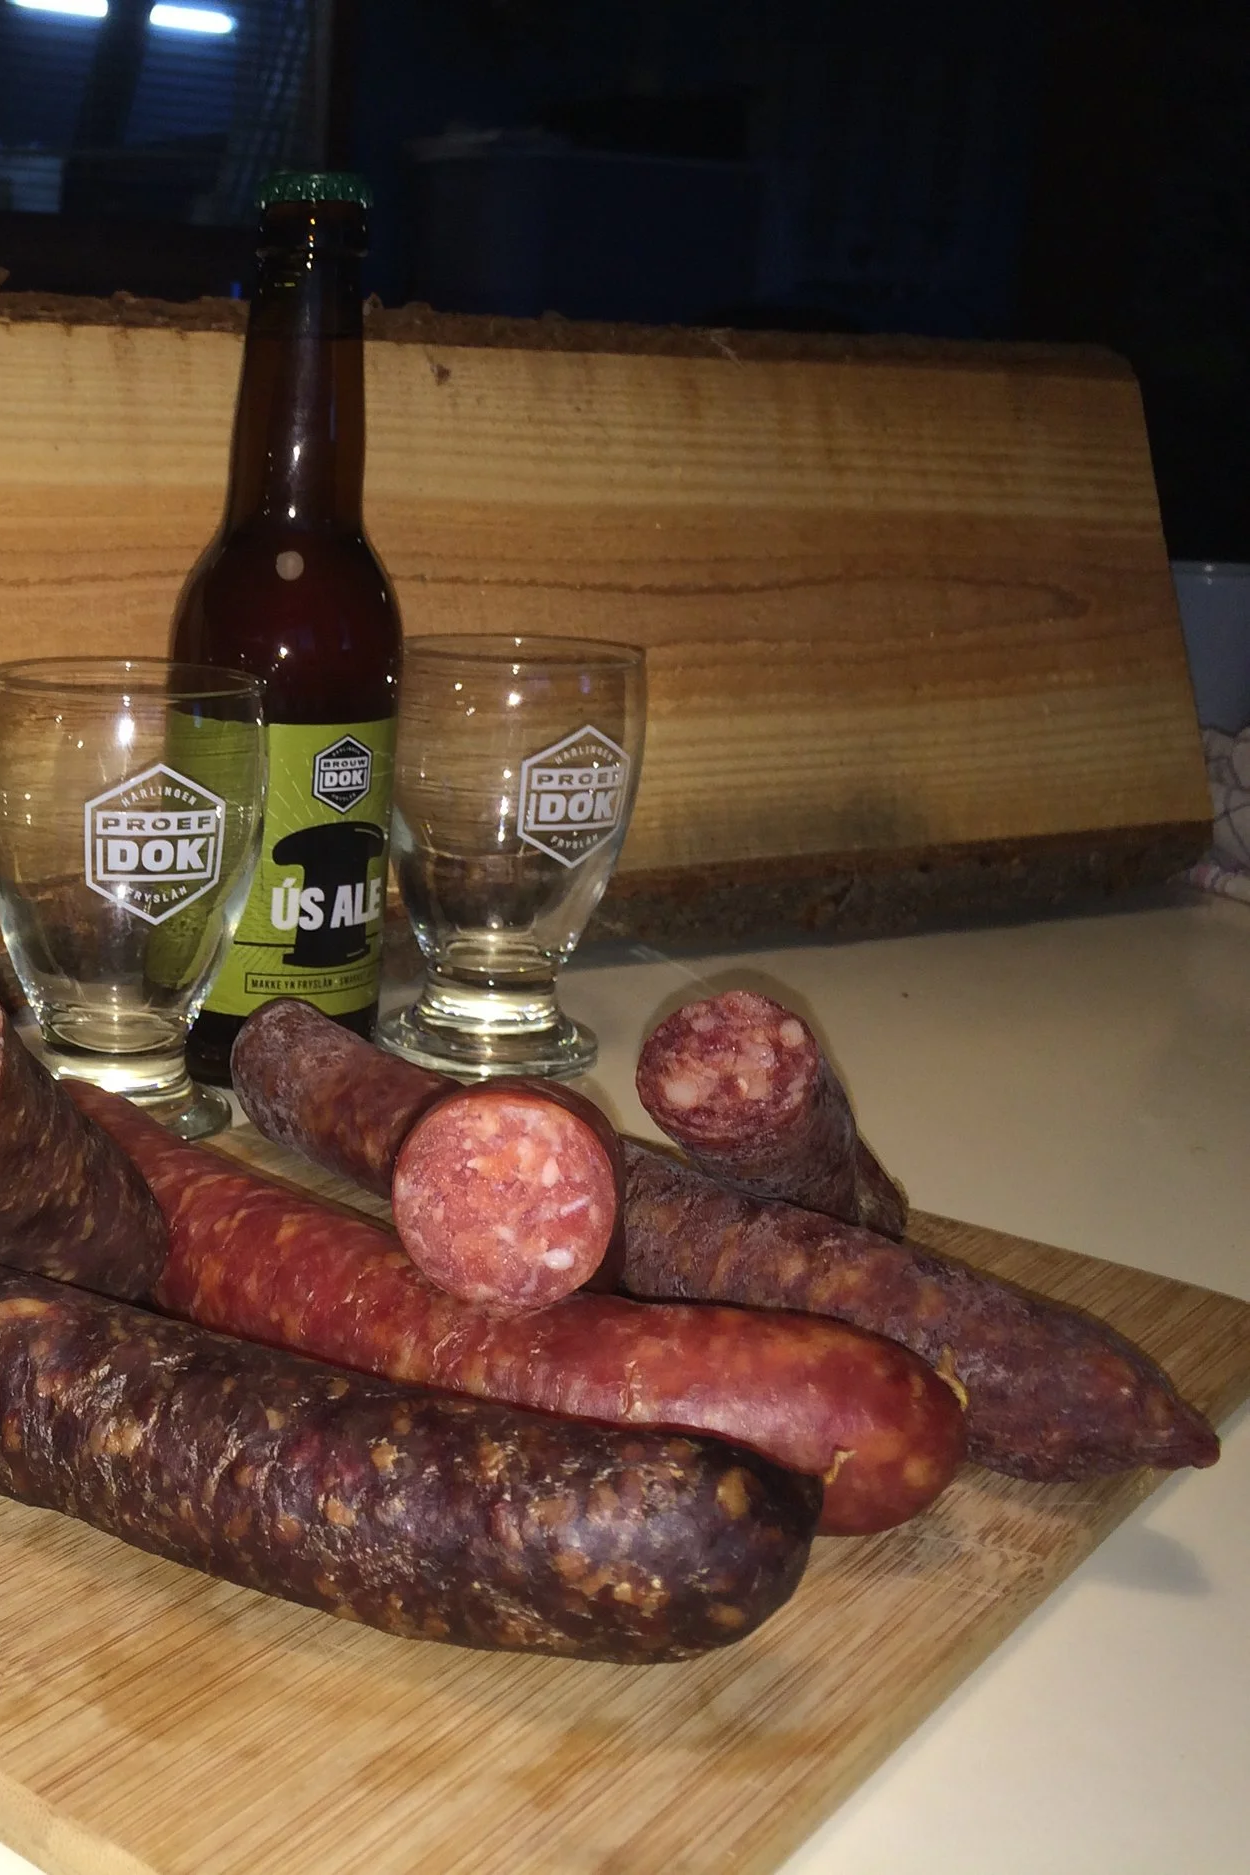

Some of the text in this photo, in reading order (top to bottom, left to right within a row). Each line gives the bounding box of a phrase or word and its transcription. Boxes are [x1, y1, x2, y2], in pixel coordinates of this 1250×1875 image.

[323, 760, 366, 768] BROUW
[324, 769, 363, 787] DOK
[120, 786, 197, 808] HARLINGEN
[538, 790, 617, 822] DOK
[102, 816, 211, 831] PROEF
[108, 838, 207, 872] DOK
[270, 877, 381, 931] ÚS ALE
